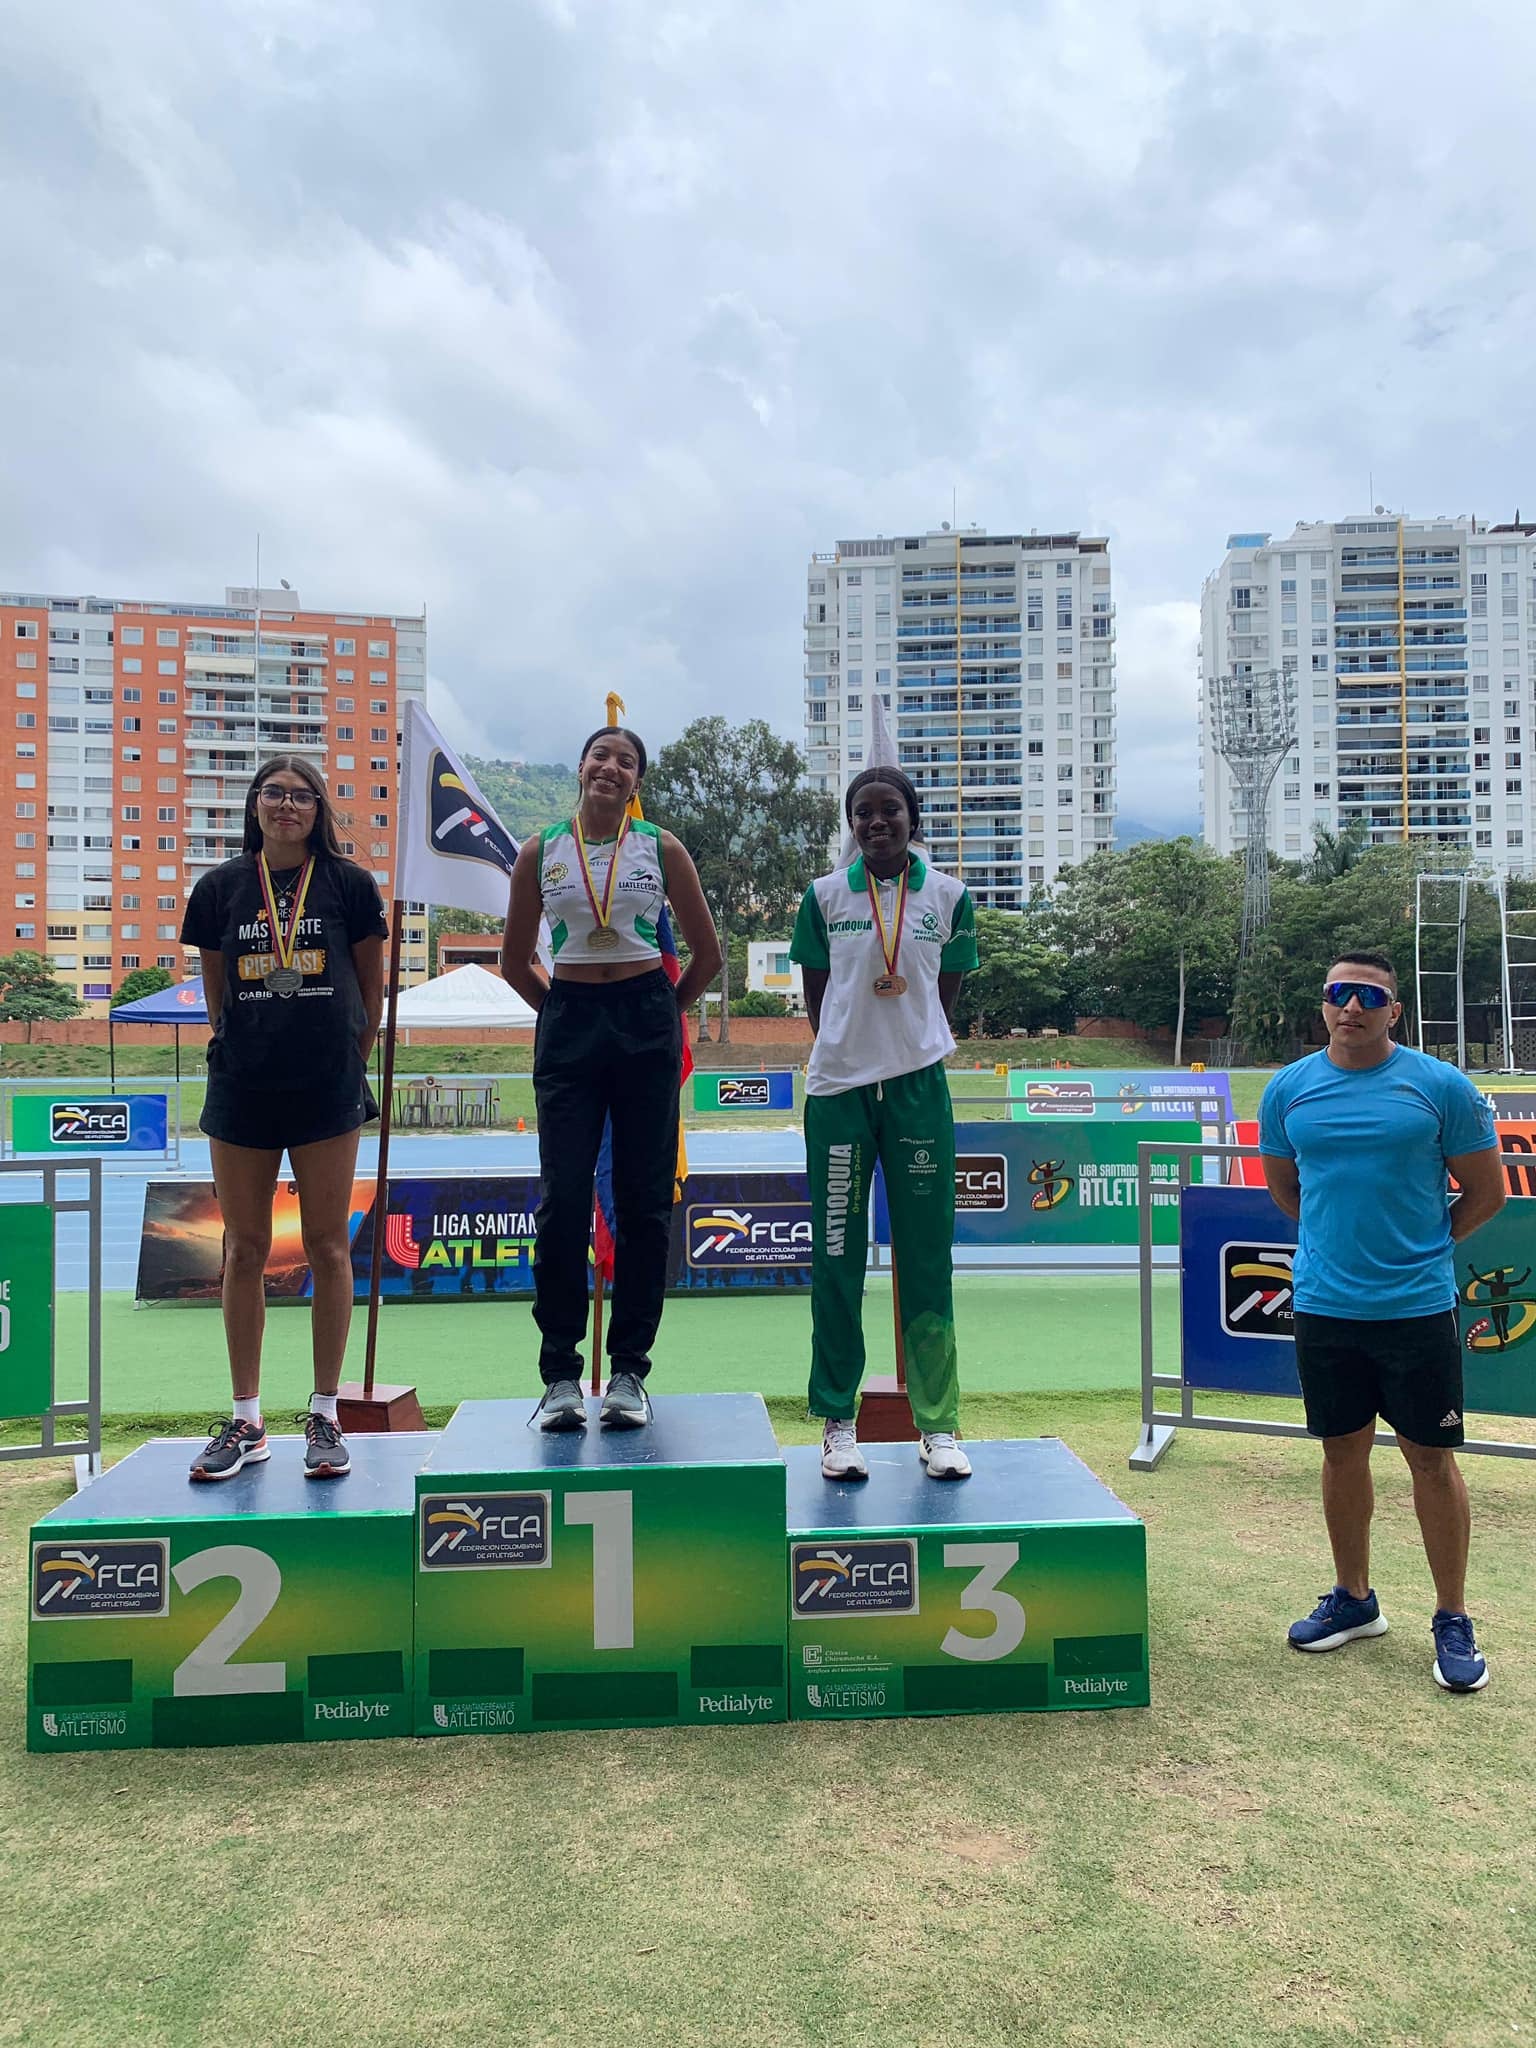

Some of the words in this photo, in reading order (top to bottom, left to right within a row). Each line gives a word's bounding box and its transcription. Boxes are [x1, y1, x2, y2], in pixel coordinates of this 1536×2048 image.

[238, 920, 269, 941] MÁS
[277, 918, 322, 938] URTE
[244, 951, 318, 977] PIENAS!
[742, 1085, 767, 1096] FCA
[88, 1114, 126, 1129] FCA
[1078, 1163, 1097, 1177] LIGA
[1100, 1163, 1168, 1177] SANTANDANA
[826, 1143, 853, 1256] ANTIOQUIA
[1079, 1177, 1179, 1206] ATLETIMO
[433, 1213, 470, 1236] LIGA
[751, 1221, 813, 1244] FCA
[420, 1237, 537, 1269] ATLET
[725, 1246, 770, 1254] FEDERACION
[756, 1253, 796, 1261] ATLETISMO
[482, 1515, 541, 1540] FCA
[458, 1543, 500, 1552] FEDERACION
[500, 1542, 543, 1551] COLOMBIANA
[486, 1551, 524, 1559] ATLETISMO
[97, 1563, 159, 1588] FCA
[564, 1489, 634, 1650] 1
[851, 1562, 908, 1587] FCA
[71, 1593, 116, 1601] FEDERACION
[116, 1591, 160, 1599] COLOMBIANA
[101, 1600, 141, 1608] ATLETISMO
[828, 1591, 869, 1599] FEDERACION
[869, 1589, 910, 1597] COLOMBIANA
[856, 1598, 892, 1606] ATLETISMO
[939, 1541, 1026, 1662] 3
[170, 1544, 286, 1697] 2
[1063, 1677, 1128, 1696] Pedialyte
[698, 1693, 774, 1715] Pedialyte
[822, 1690, 886, 1708] ATLETISMO
[313, 1700, 390, 1722] Pedialyte
[449, 1709, 515, 1728] ATLETISMO
[58, 1718, 127, 1737] ATLETISMO
